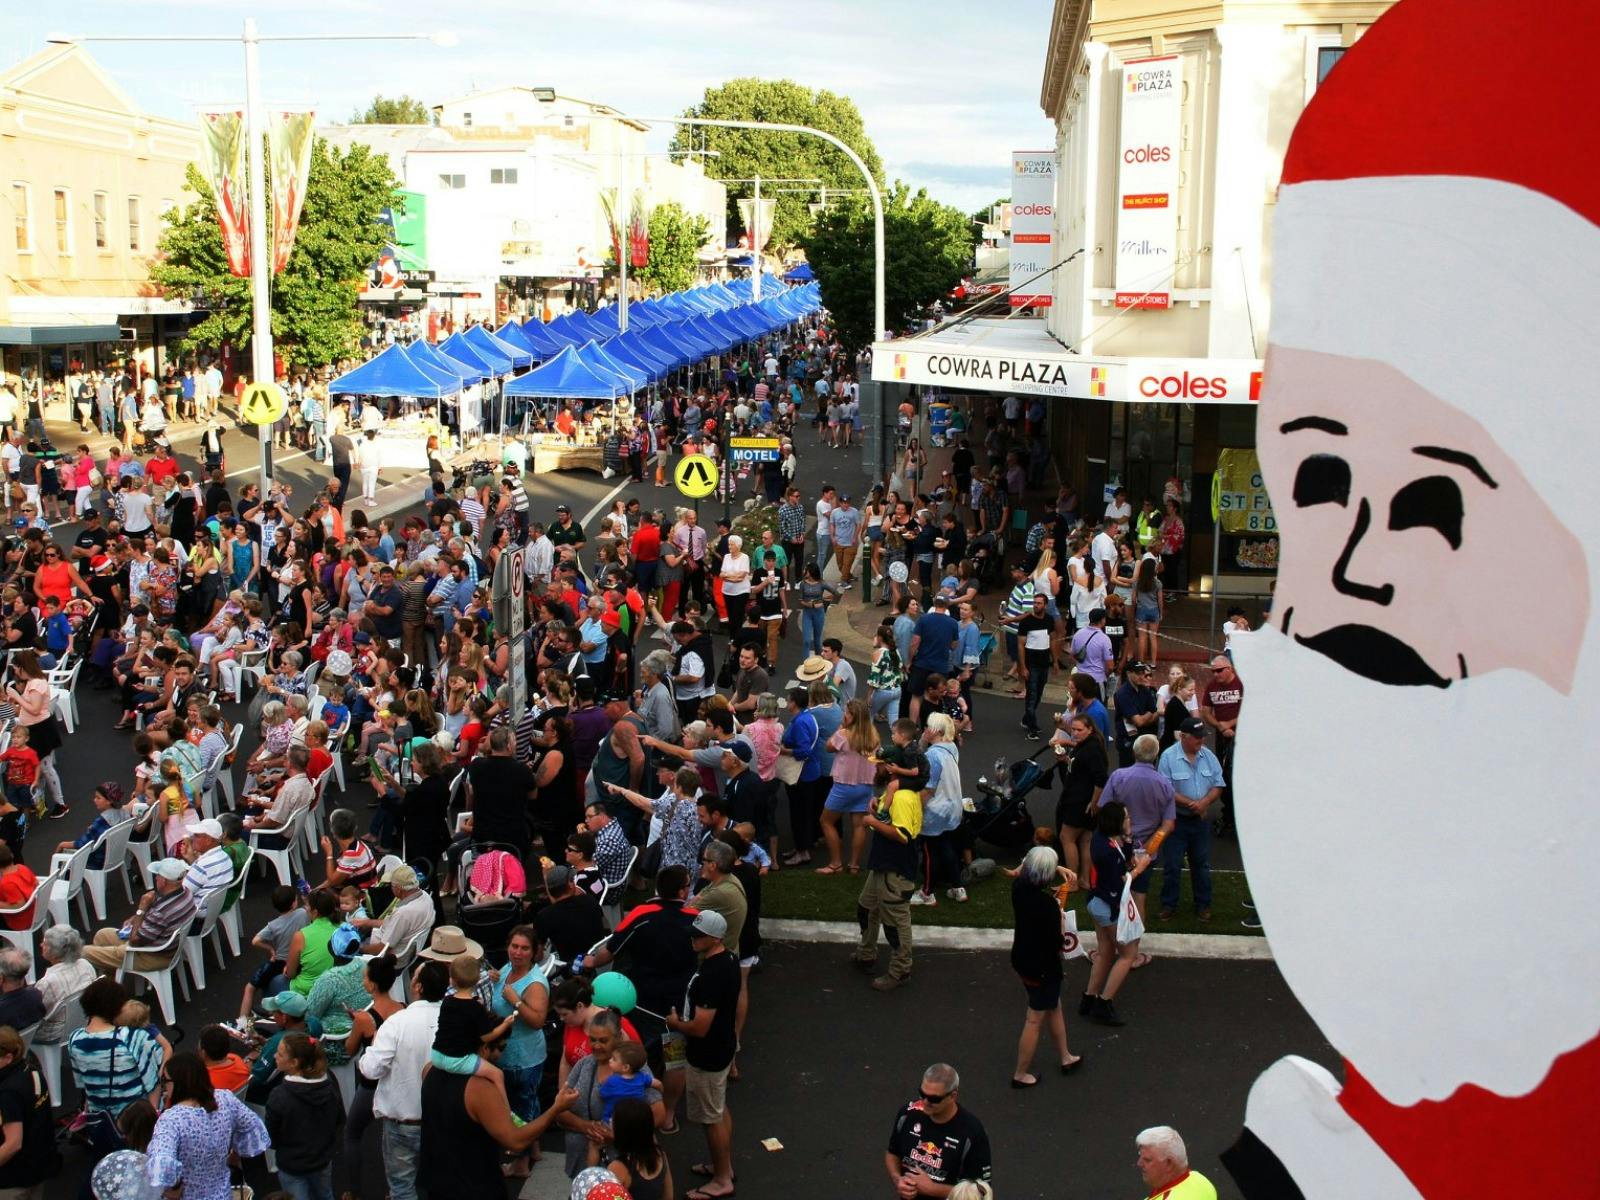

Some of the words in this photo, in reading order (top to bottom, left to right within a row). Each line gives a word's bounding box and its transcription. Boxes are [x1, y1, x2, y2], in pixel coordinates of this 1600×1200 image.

[1137, 70, 1172, 82] COWRA
[1137, 80, 1173, 92] PLAZA
[1124, 144, 1170, 164] coles
[1014, 203, 1052, 216] coles
[1121, 240, 1167, 256] Millers
[410, 270, 429, 281] Plus
[927, 355, 993, 379] COWRA
[999, 361, 1068, 385] PLAZA
[1011, 382, 1045, 392] SHOPPING
[1045, 385, 1069, 396] CENTRE
[1139, 371, 1227, 398] coles
[733, 450, 777, 461] MOTEL
